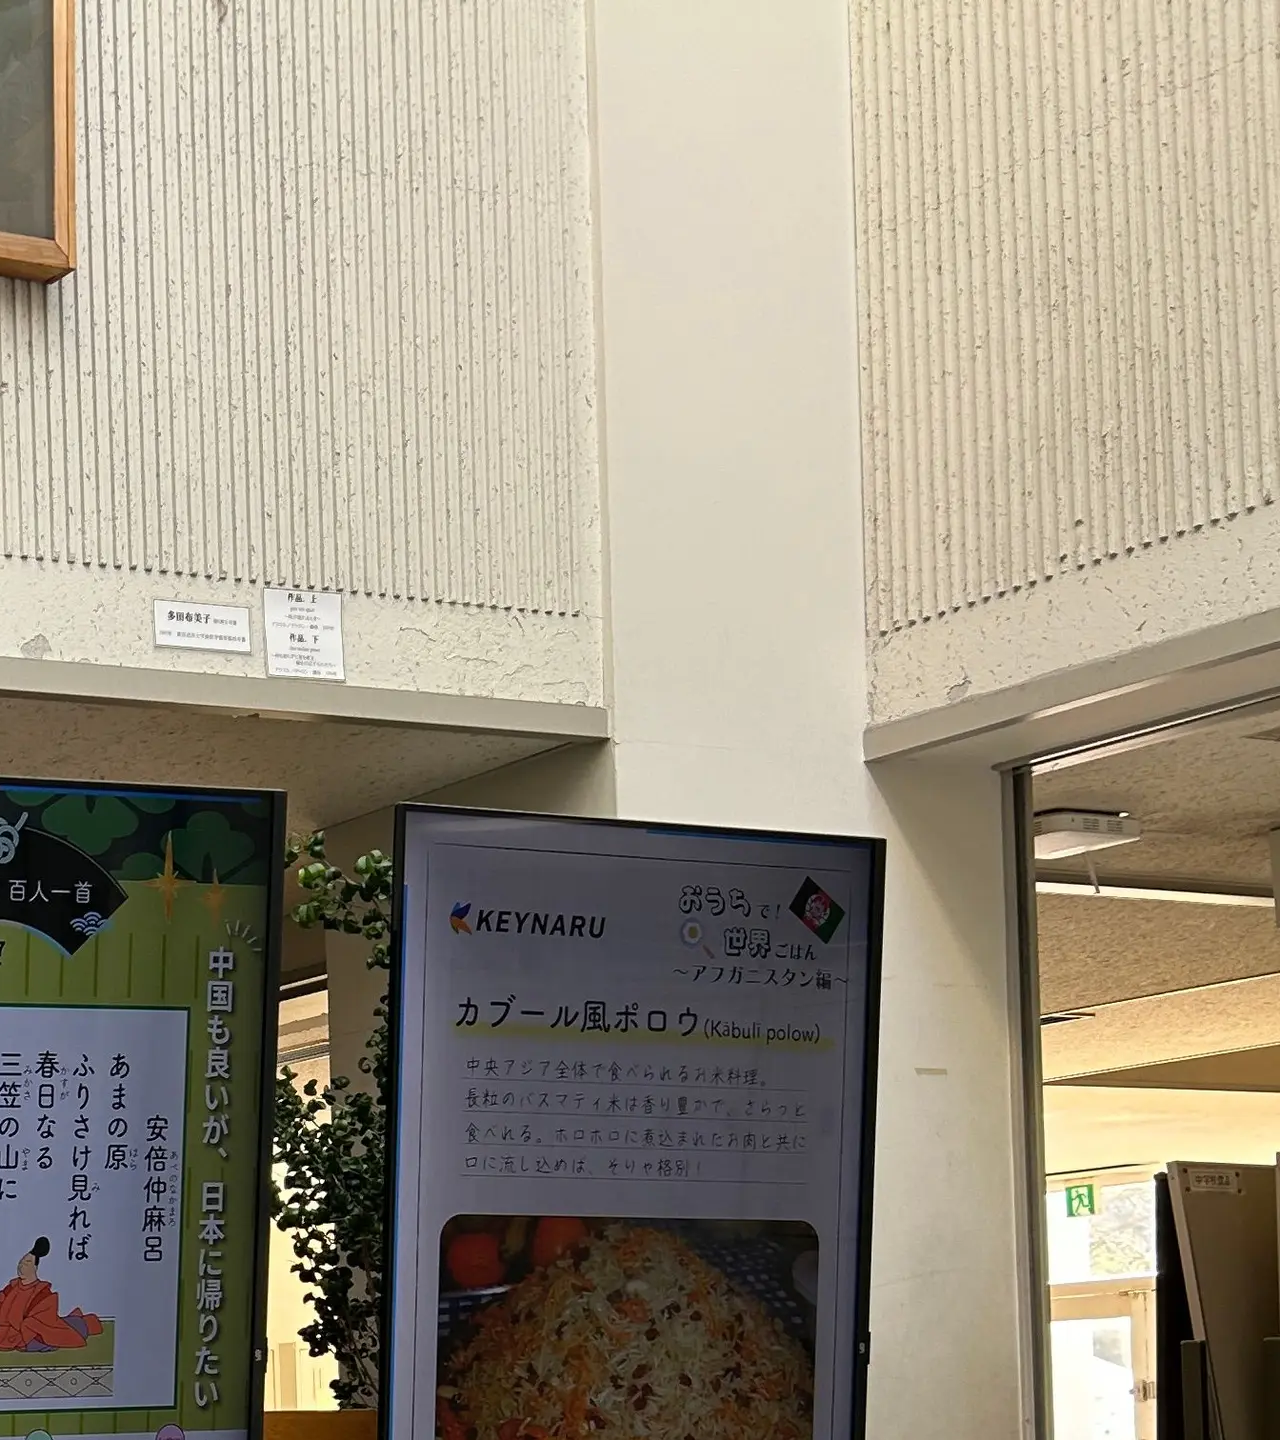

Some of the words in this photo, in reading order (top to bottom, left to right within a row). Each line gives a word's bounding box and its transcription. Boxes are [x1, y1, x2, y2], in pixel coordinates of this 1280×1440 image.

[476, 909, 606, 939] KEYNARU
[723, 926, 818, 961] 世界ごはん
[455, 995, 699, 1036] カブール風ポロウ
[766, 1023, 821, 1045] polow)
[35, 1050, 60, 1170] 春日なる
[68, 1053, 95, 1261] ふりさけ見れば
[104, 1053, 130, 1171] あまの原
[142, 1114, 169, 1263] 安倍仲麻呂
